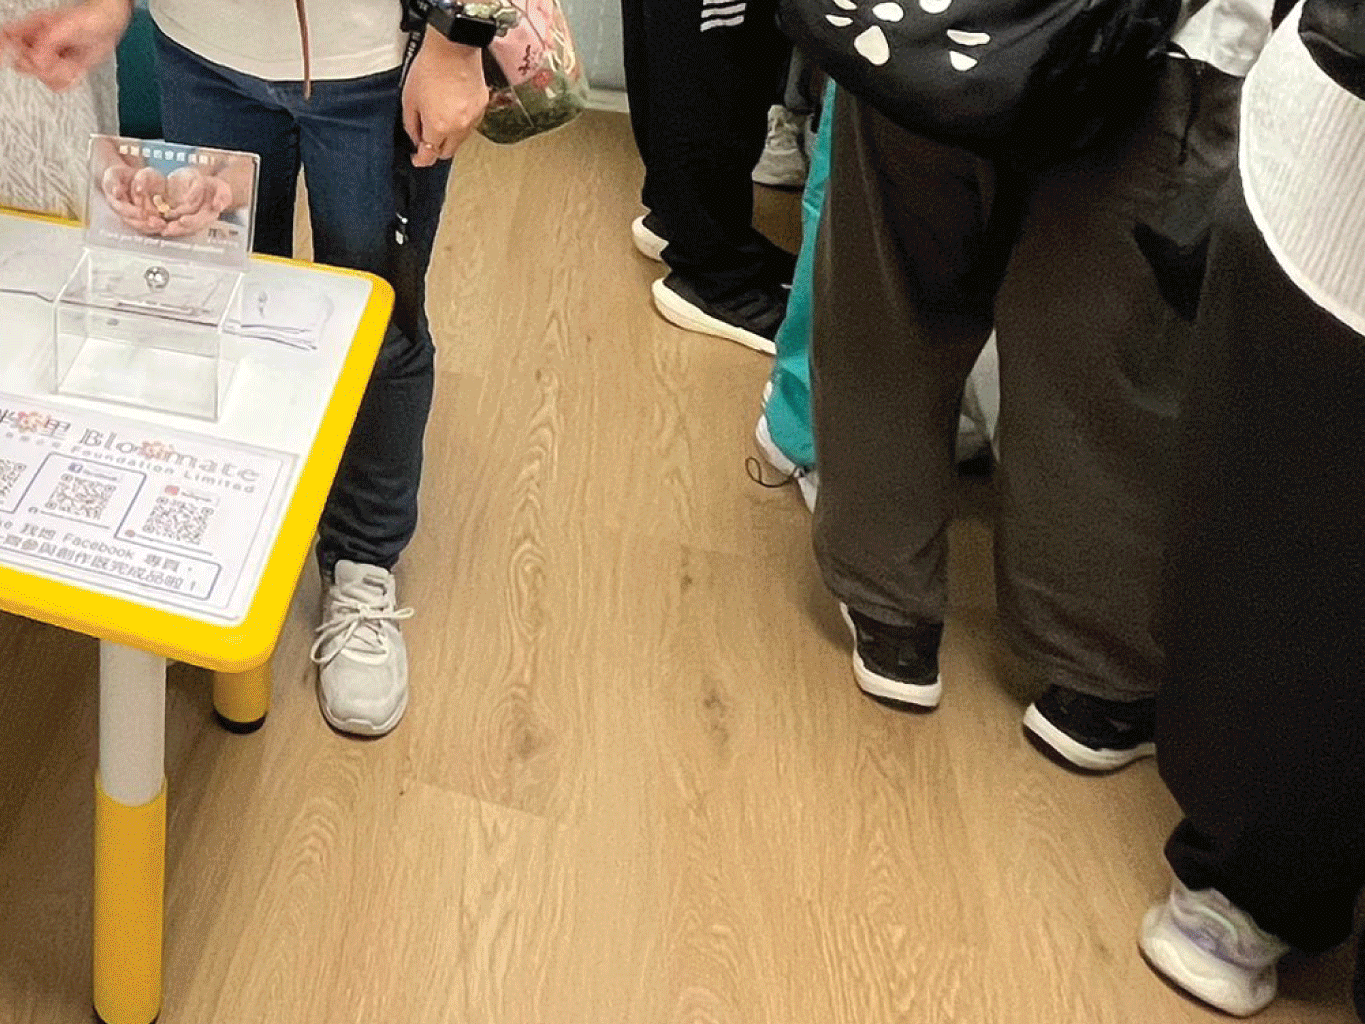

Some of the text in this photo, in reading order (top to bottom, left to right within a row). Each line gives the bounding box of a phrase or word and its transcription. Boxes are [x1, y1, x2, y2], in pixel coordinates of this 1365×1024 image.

[70, 445, 257, 494] Foundation Limited
[62, 532, 136, 560] Facebook
